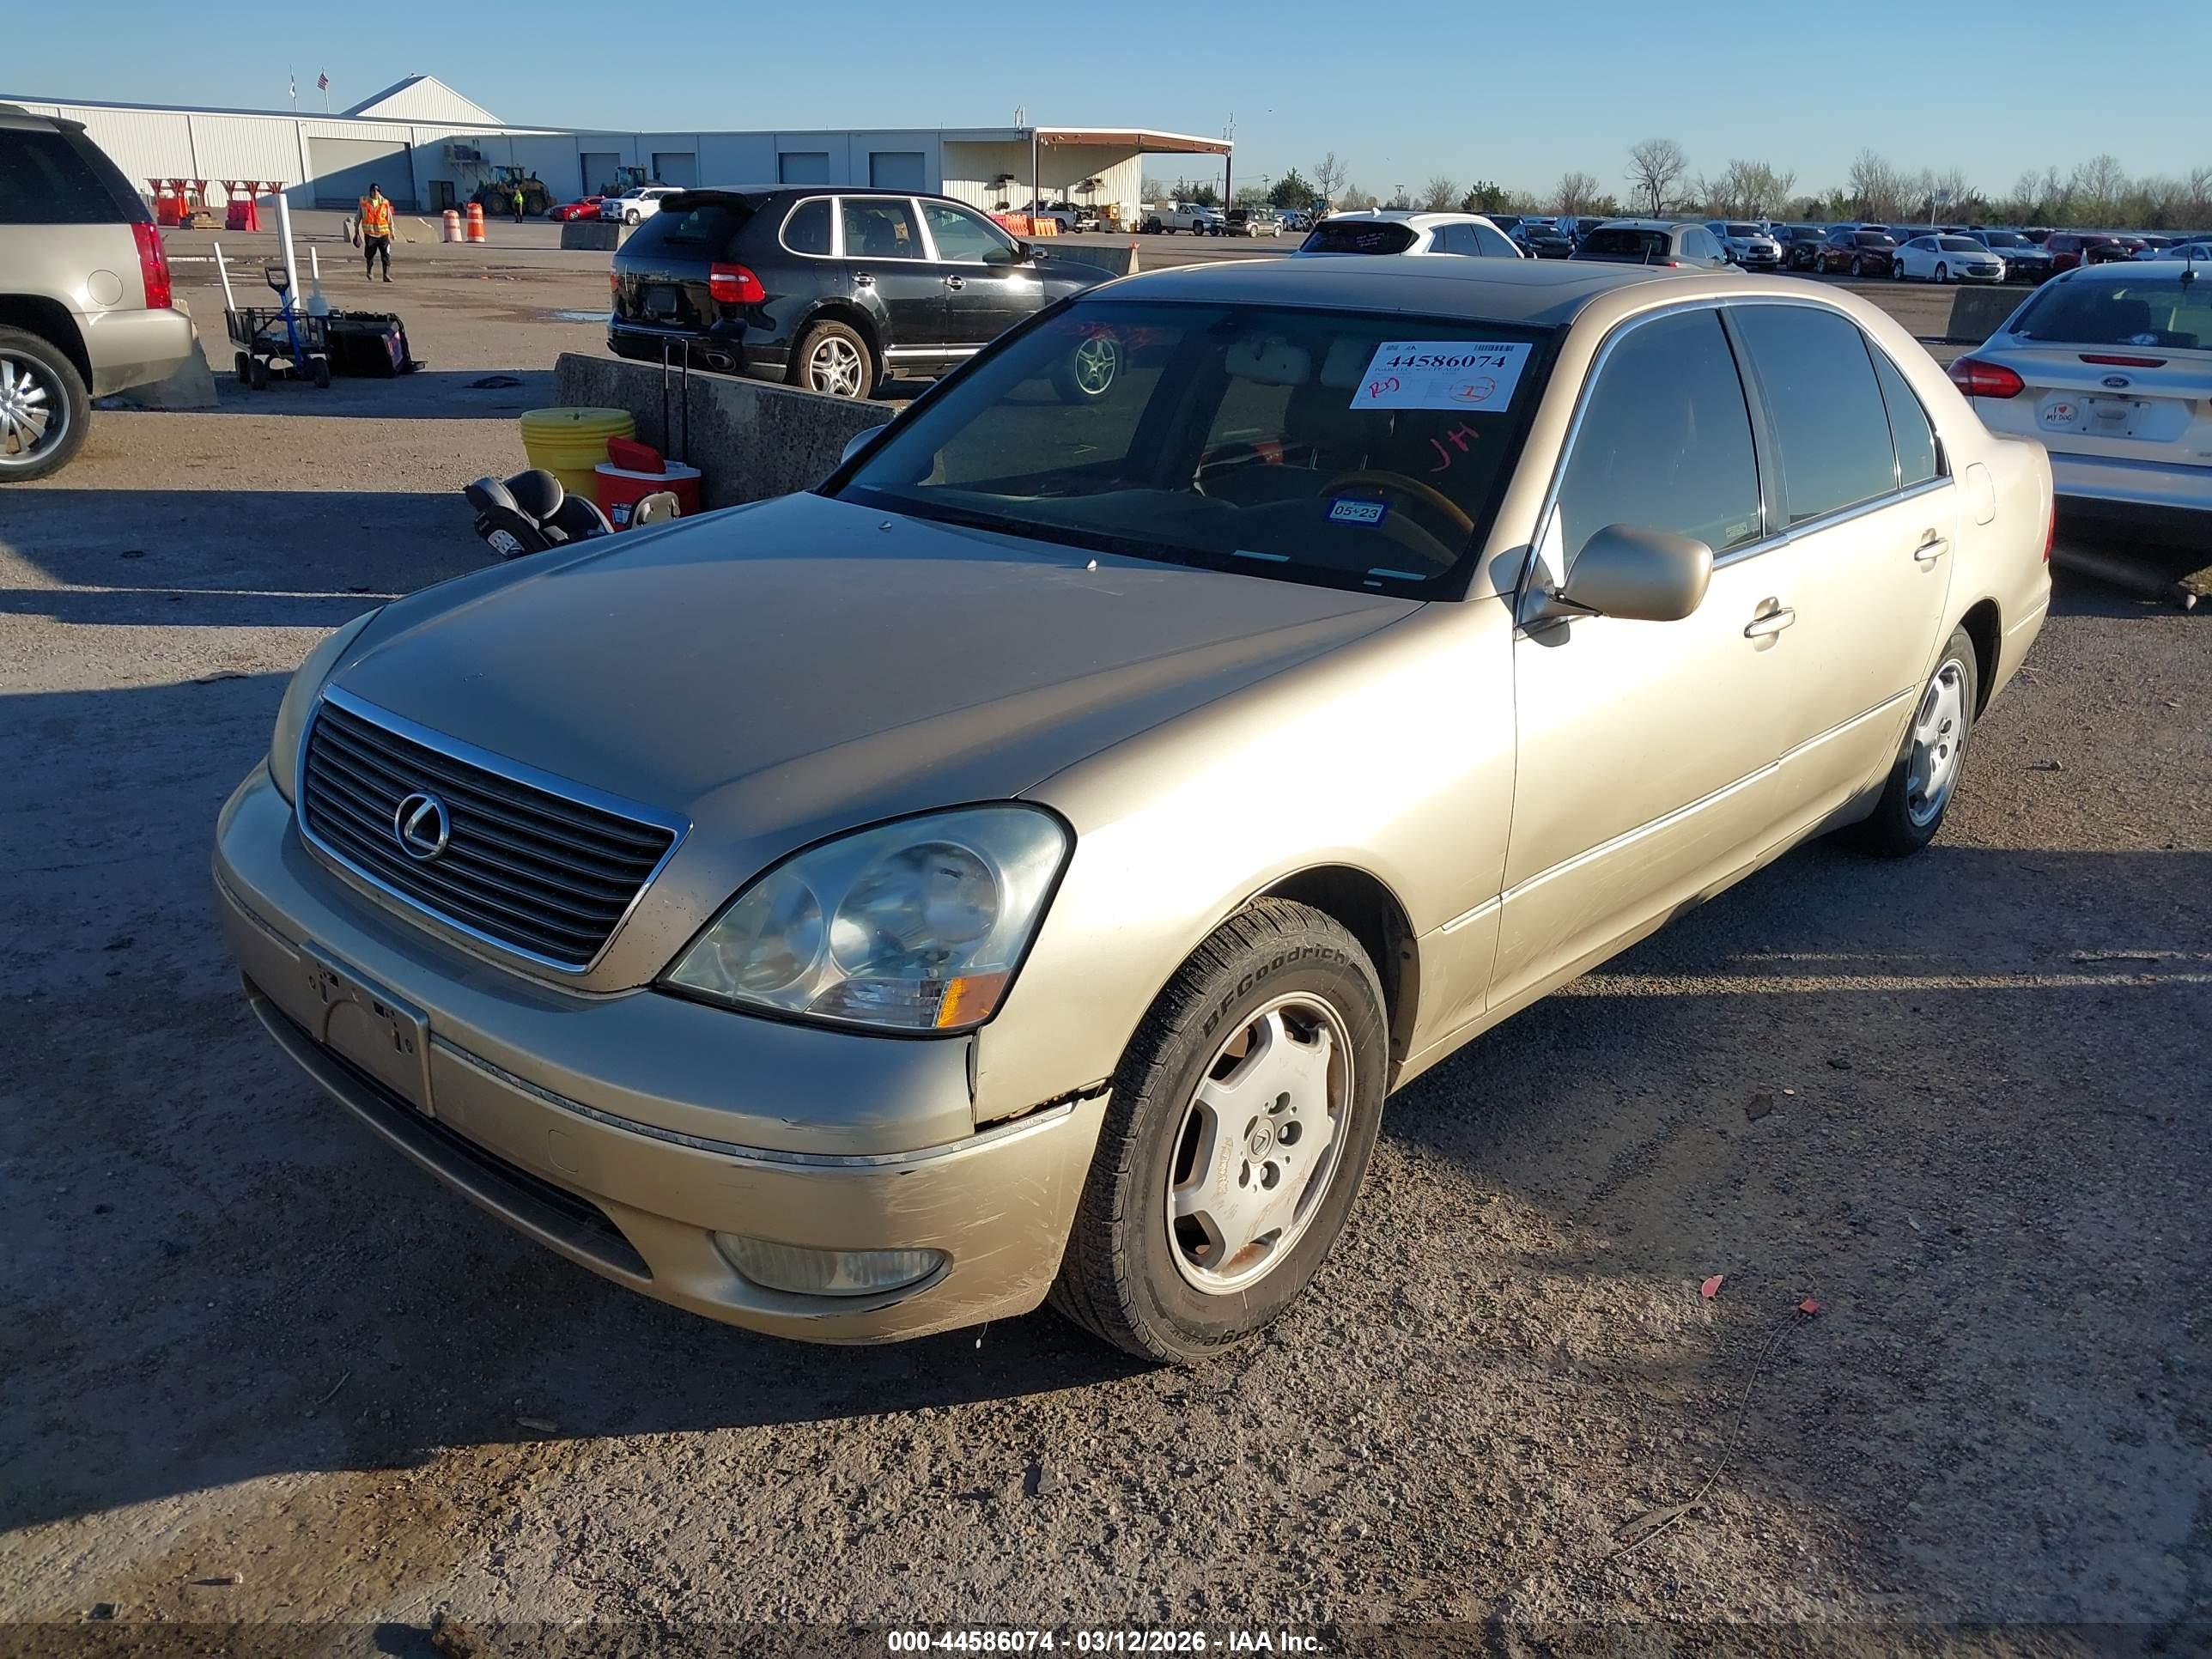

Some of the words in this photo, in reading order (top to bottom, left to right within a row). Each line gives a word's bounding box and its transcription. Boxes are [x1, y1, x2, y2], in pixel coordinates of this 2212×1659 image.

[1387, 355, 1505, 368] 44586074
[1334, 506, 1353, 516] 05
[1358, 507, 1379, 519] 23
[1202, 944, 1346, 1038] BFGoodrich
